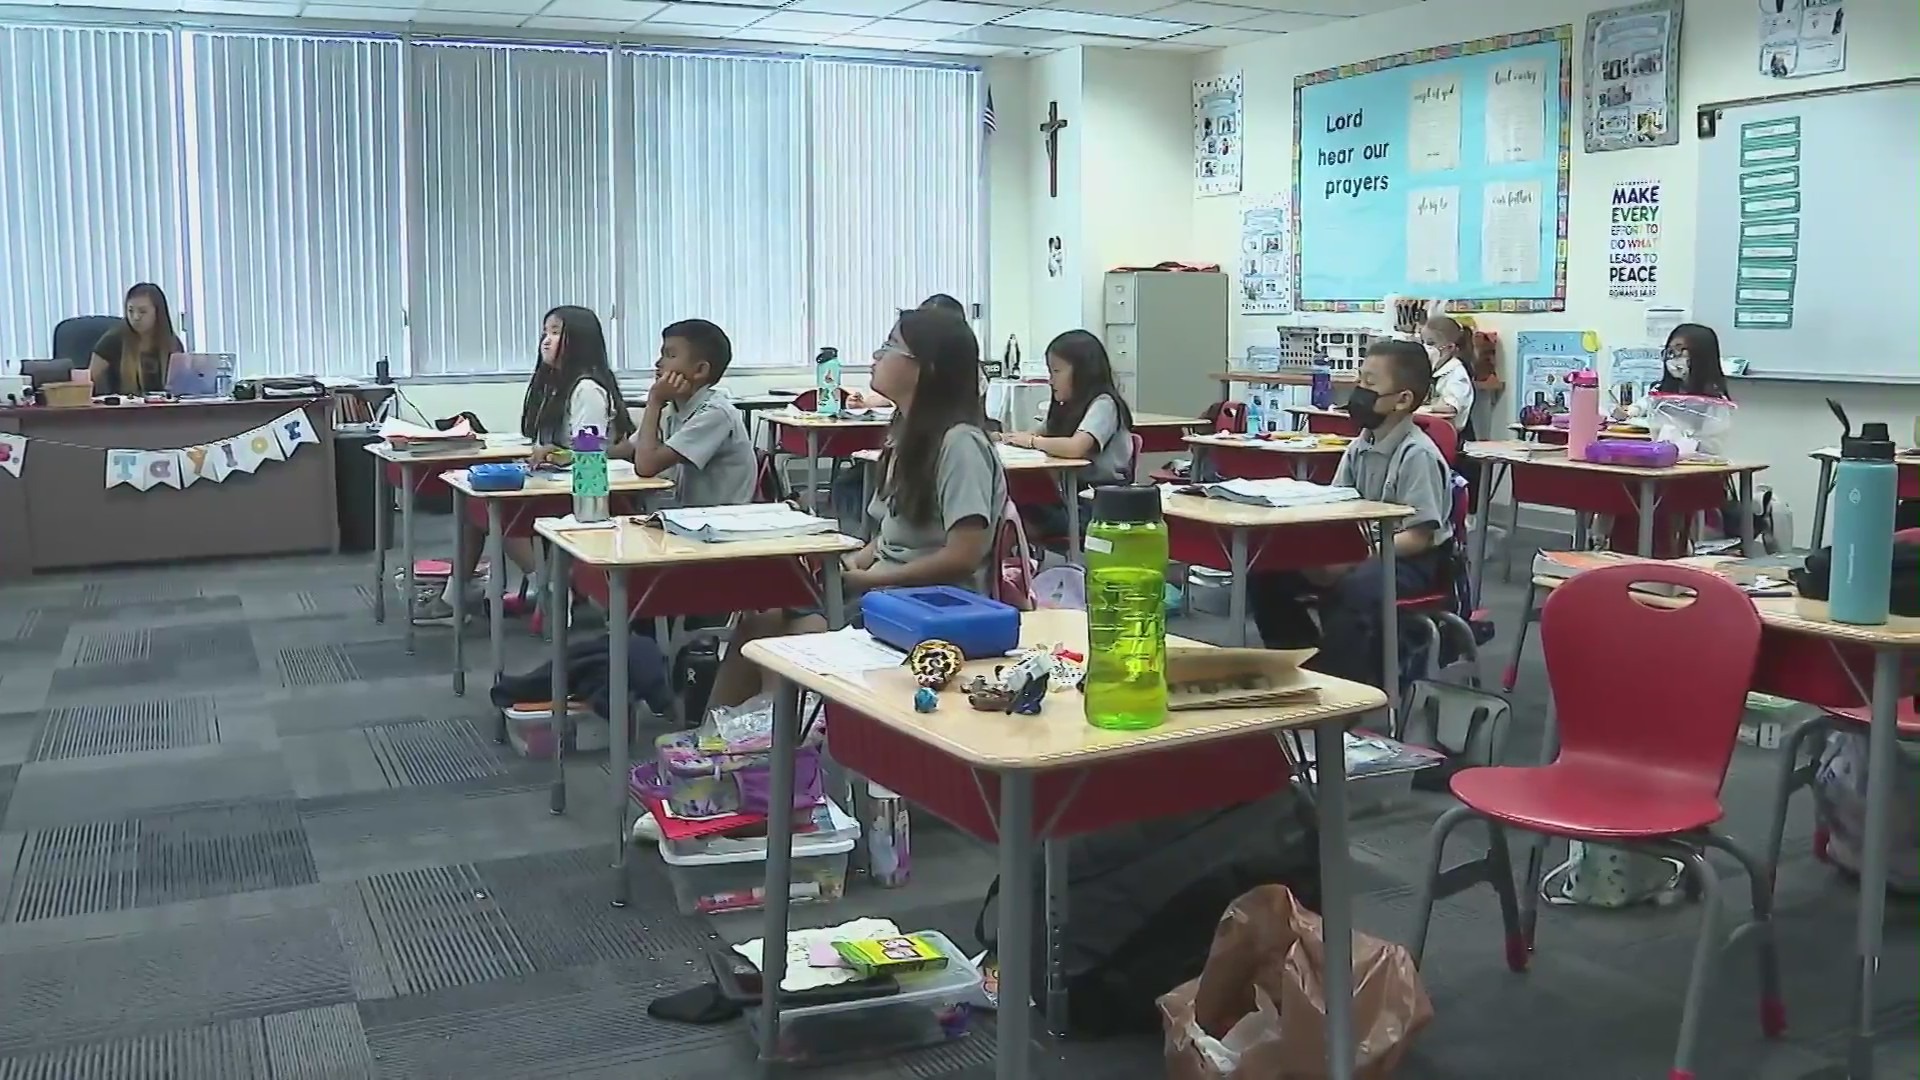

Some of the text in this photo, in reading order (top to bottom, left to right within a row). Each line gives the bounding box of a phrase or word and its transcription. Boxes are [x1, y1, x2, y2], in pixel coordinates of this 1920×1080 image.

[1326, 108, 1363, 133] Lord
[1318, 142, 1389, 167] hear our
[1325, 175, 1389, 199] prayers
[1612, 185, 1660, 205] MAKE
[1611, 205, 1660, 223] EVERY
[1646, 223, 1659, 234] TO
[1610, 238, 1658, 250] DO WHAT
[1609, 253, 1658, 264] LEADS TO
[1609, 265, 1658, 282] PEACE
